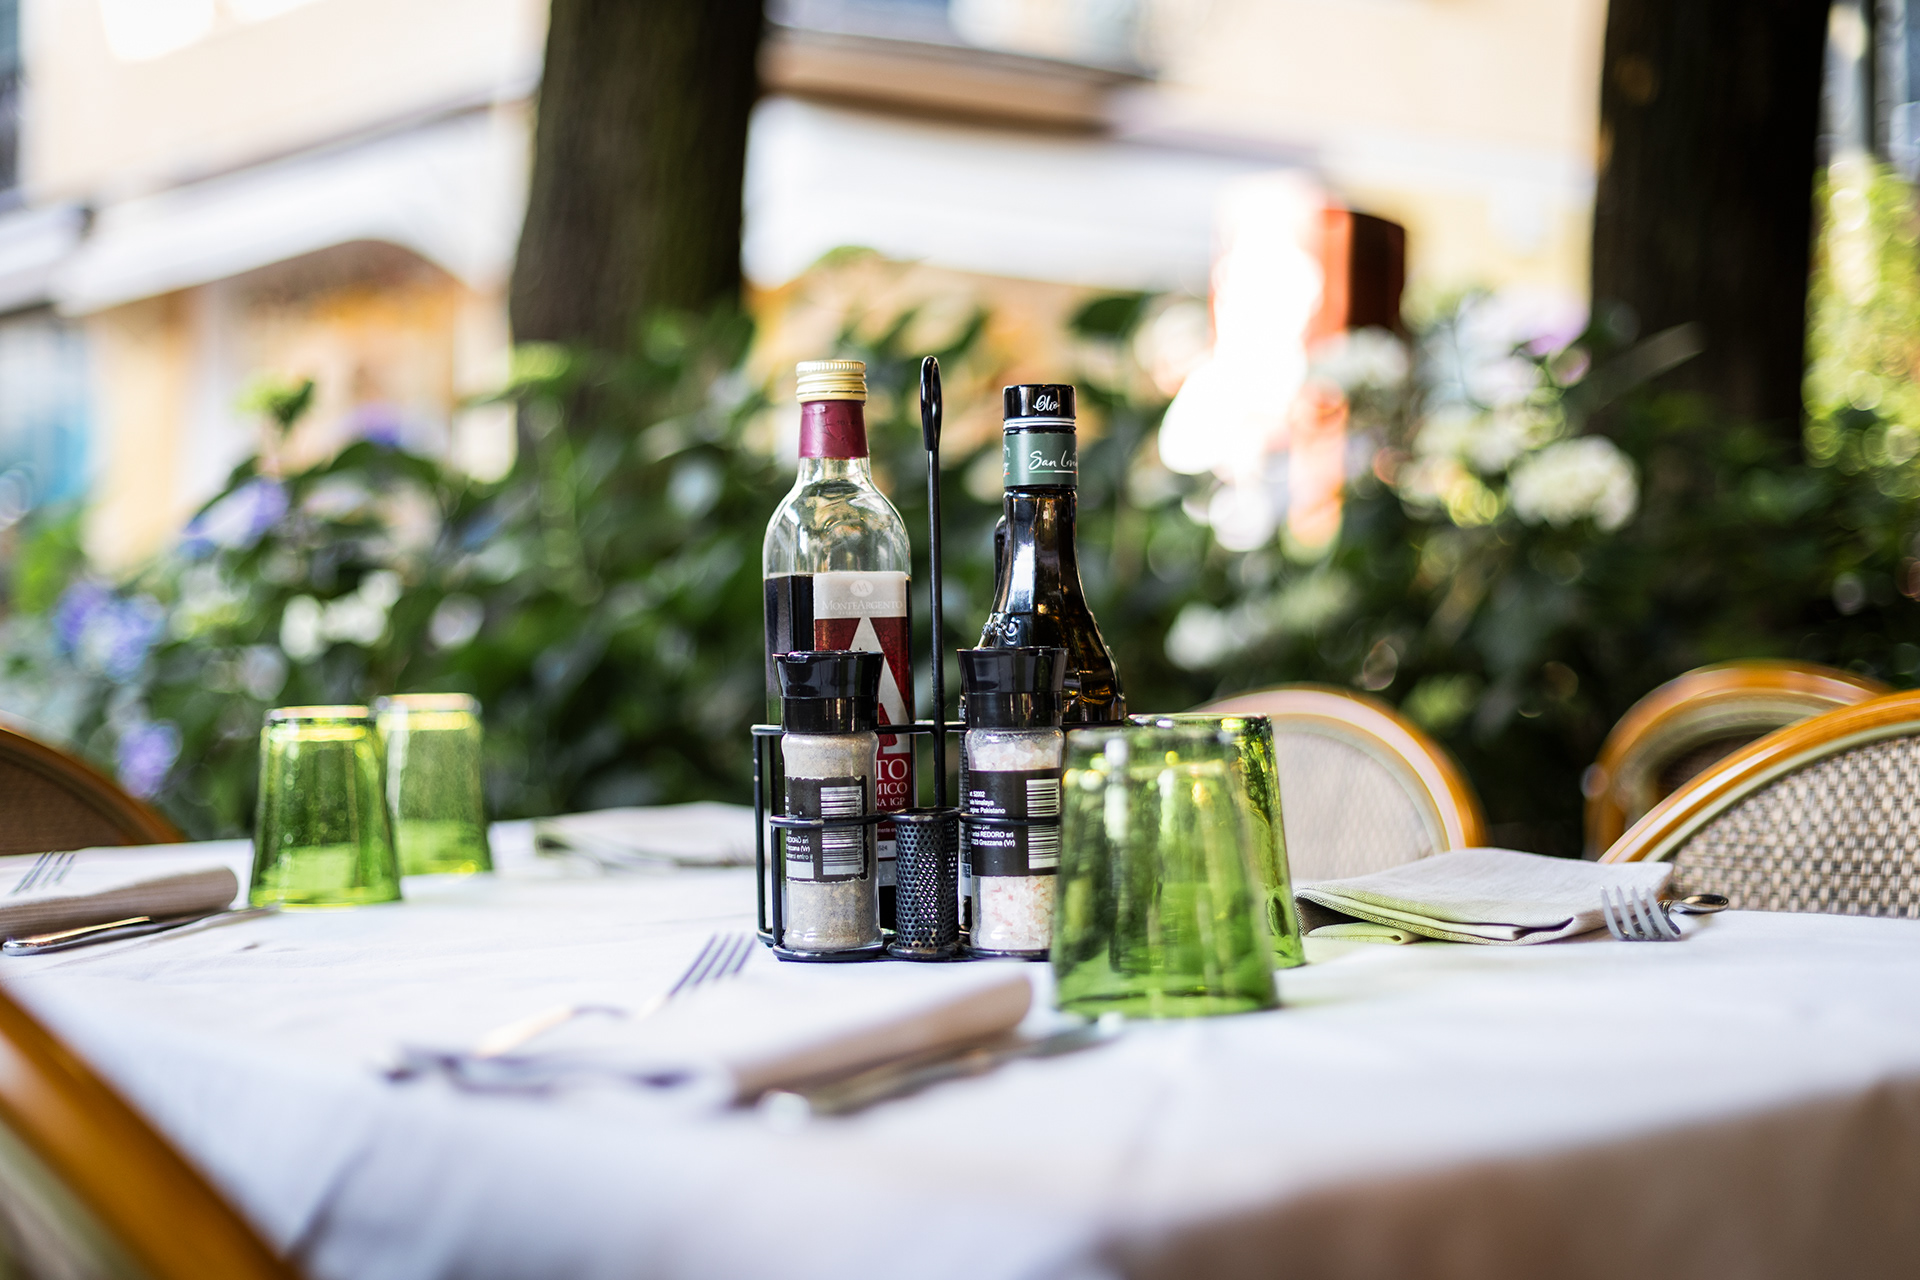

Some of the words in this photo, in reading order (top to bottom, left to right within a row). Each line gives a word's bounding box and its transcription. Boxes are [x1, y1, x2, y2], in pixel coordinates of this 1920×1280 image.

[1028, 450, 1057, 470] San
[876, 758, 908, 780] TO
[889, 797, 905, 807] IGP
[980, 830, 1005, 838] REDORO
